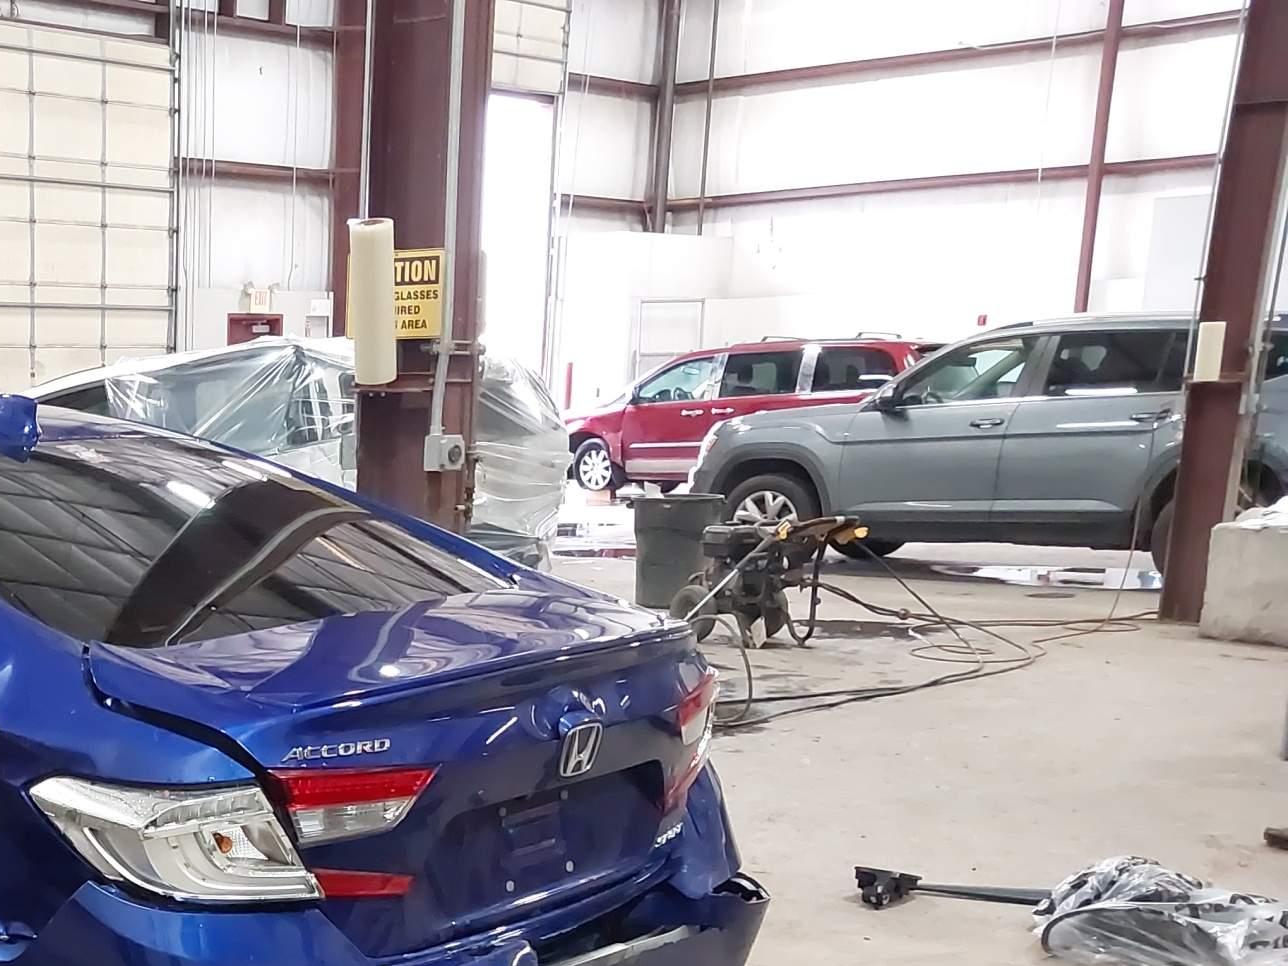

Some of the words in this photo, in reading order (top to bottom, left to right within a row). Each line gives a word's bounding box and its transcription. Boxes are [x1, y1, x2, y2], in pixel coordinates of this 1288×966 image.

[394, 260, 437, 282] TION
[394, 290, 439, 301] GLASSES
[394, 305, 421, 316] IRED
[401, 319, 428, 330] AREA
[280, 739, 391, 762] ACCORD
